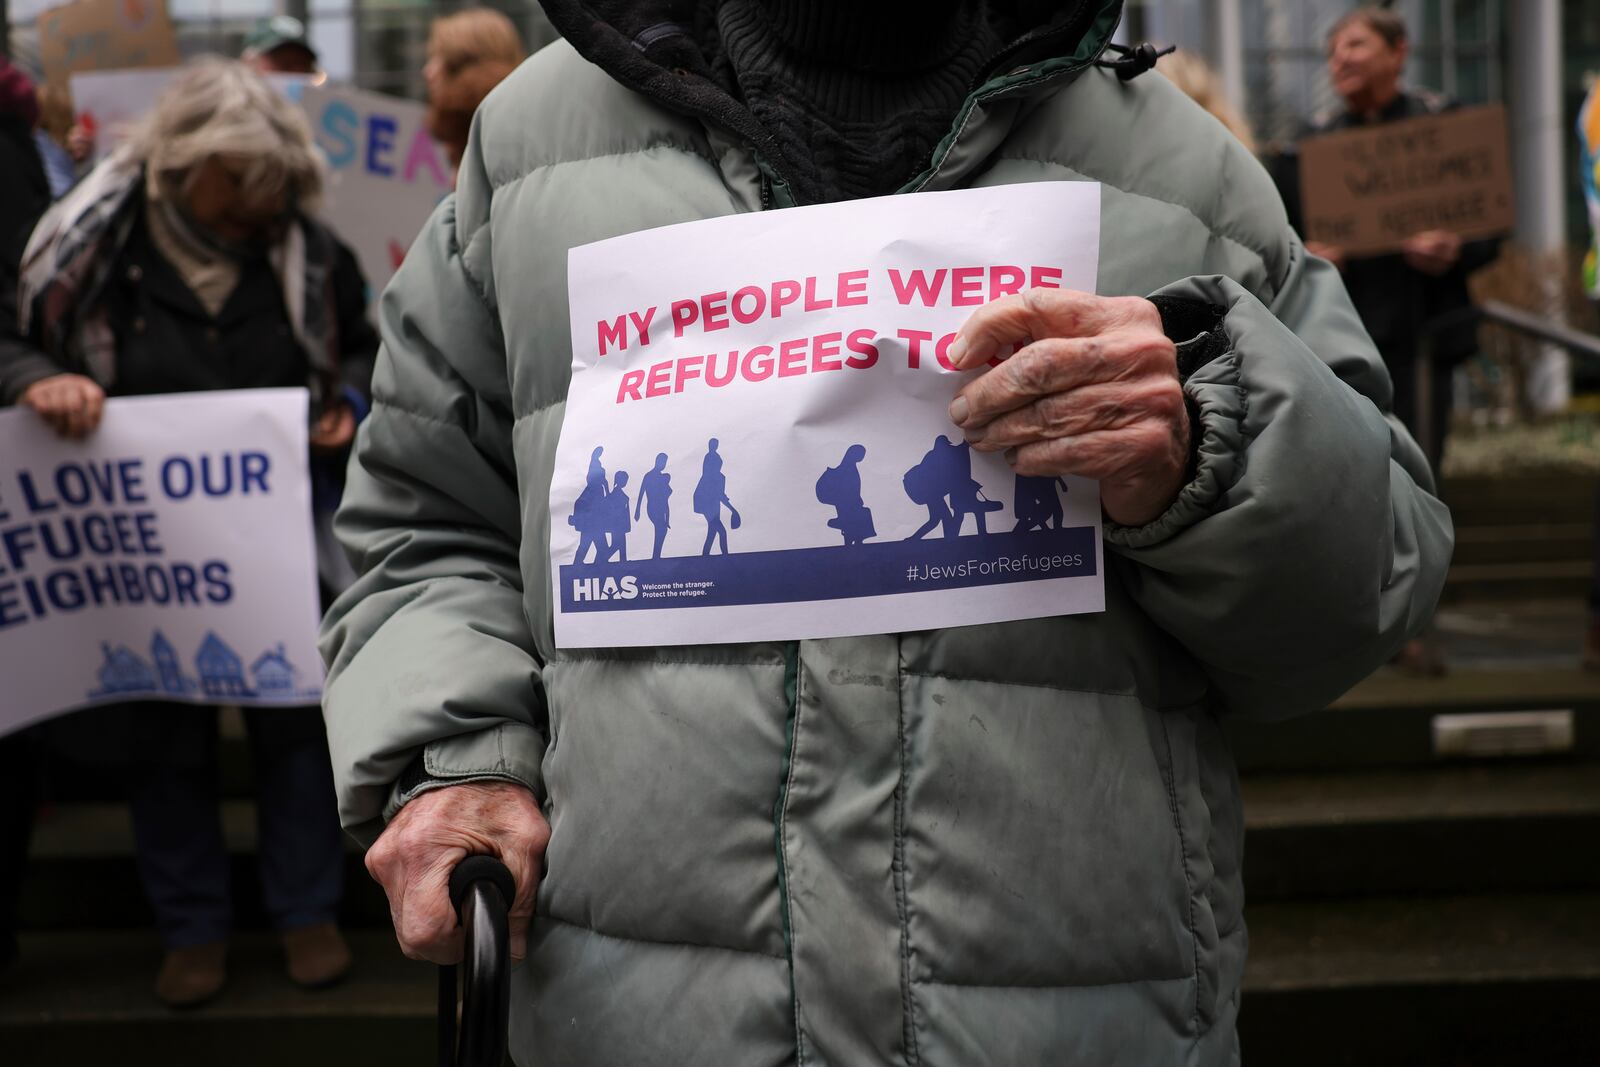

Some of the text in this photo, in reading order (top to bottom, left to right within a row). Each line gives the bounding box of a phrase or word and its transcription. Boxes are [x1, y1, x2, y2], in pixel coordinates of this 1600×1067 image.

[597, 306, 657, 356] MY
[671, 269, 870, 337] PEOPLE
[616, 328, 880, 404] REFUGEES
[17, 461, 148, 515] LOVE
[161, 453, 270, 499] OUR
[0, 512, 163, 575] FUGEE
[573, 575, 639, 602] HIAS
[642, 581, 715, 591] Welcome the stranger.
[906, 553, 1083, 582] #JewsForRefugees
[642, 588, 707, 598] Protect the refugee.
